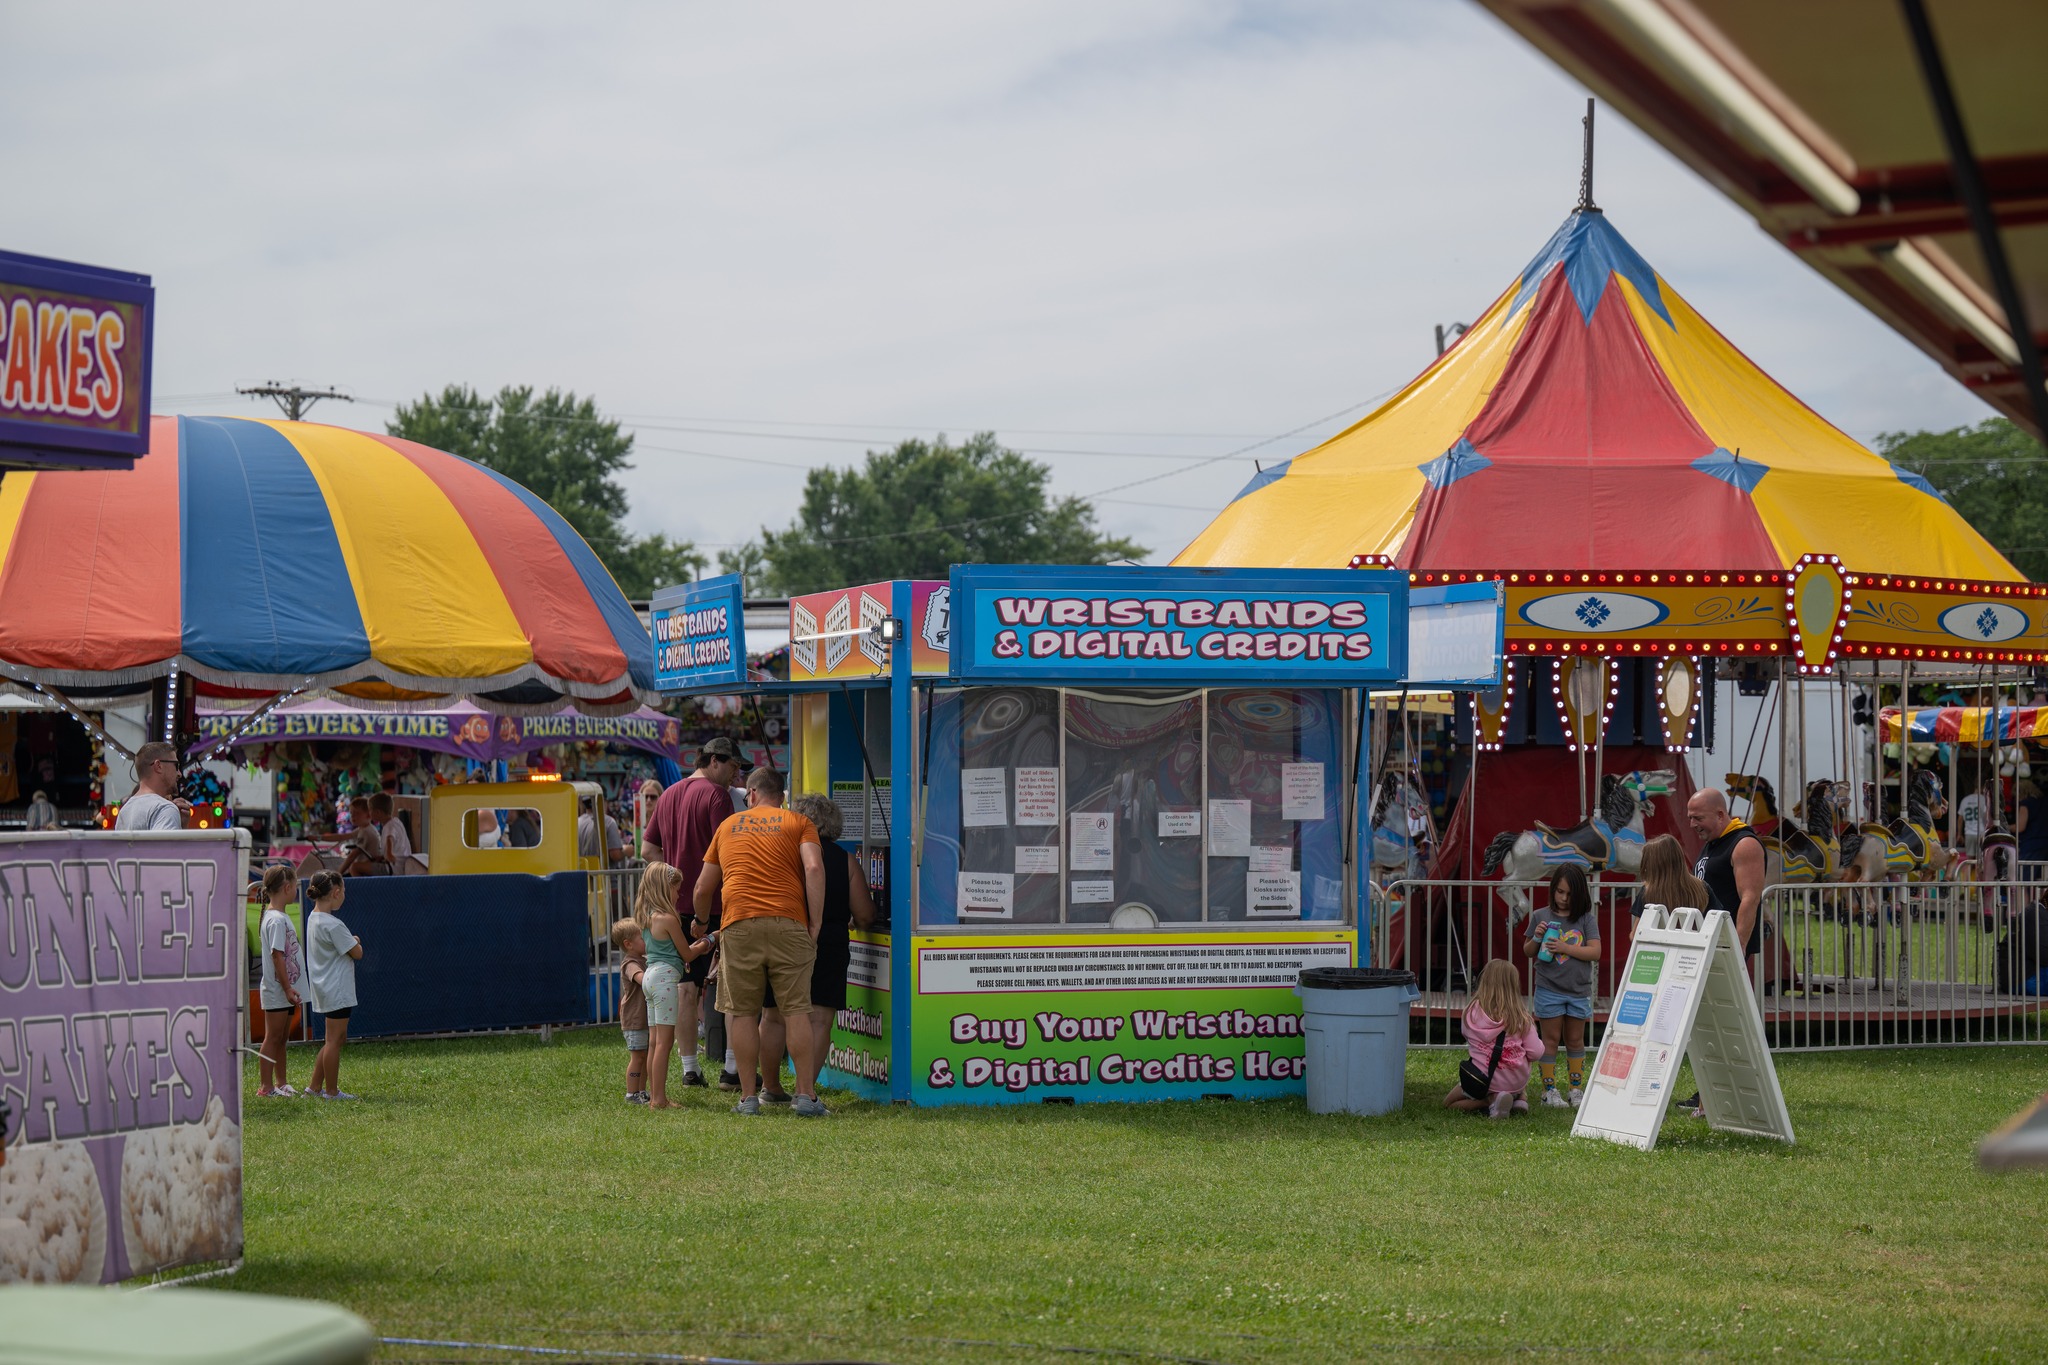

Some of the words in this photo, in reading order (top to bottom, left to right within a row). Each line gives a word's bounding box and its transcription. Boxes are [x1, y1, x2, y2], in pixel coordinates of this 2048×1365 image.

[0, 298, 124, 419] AKES
[656, 605, 728, 643] WRISTBANDS
[993, 597, 1367, 628] WRISTBANDS
[665, 641, 695, 671] DIGITAL
[694, 637, 731, 667] CREDITS
[993, 629, 1023, 659] &
[1029, 630, 1192, 660] DIGITAL
[1199, 631, 1373, 660] CREDITS
[284, 714, 449, 737] EVERYTIME
[522, 716, 572, 738] PRIZE
[575, 716, 660, 740] EVERYTIME
[932, 953, 946, 961] RIDES
[947, 953, 959, 961] HAVE
[1013, 952, 1029, 960] PLEASE
[1140, 950, 1169, 958] PURCHASING
[969, 966, 1002, 974] WRISTBANDS
[1033, 965, 1057, 973] REPLACED
[1166, 963, 1176, 971] CUT
[1223, 962, 1230, 970] OR
[1274, 961, 1303, 969] EXCEPTIONS
[977, 980, 994, 988] PLEASE
[1014, 979, 1025, 987] CELL
[1085, 978, 1094, 986] AND
[1095, 978, 1105, 986] ANY
[1138, 977, 1160, 985] ARTICLES
[1161, 977, 1167, 985] AS
[1197, 976, 1228, 984] RESPONSIBLE
[1251, 975, 1258, 983] OR
[1258, 975, 1282, 983] DAMAGED
[836, 1007, 882, 1040] Wristband
[952, 1013, 1027, 1049] Buy
[1035, 1011, 1124, 1041] Your
[1132, 1009, 1305, 1040] Wristban
[829, 1042, 861, 1076] Credits
[862, 1050, 889, 1084] Here!
[929, 1058, 954, 1088] &
[963, 1055, 1091, 1091] Digital
[1098, 1053, 1235, 1083] Credits
